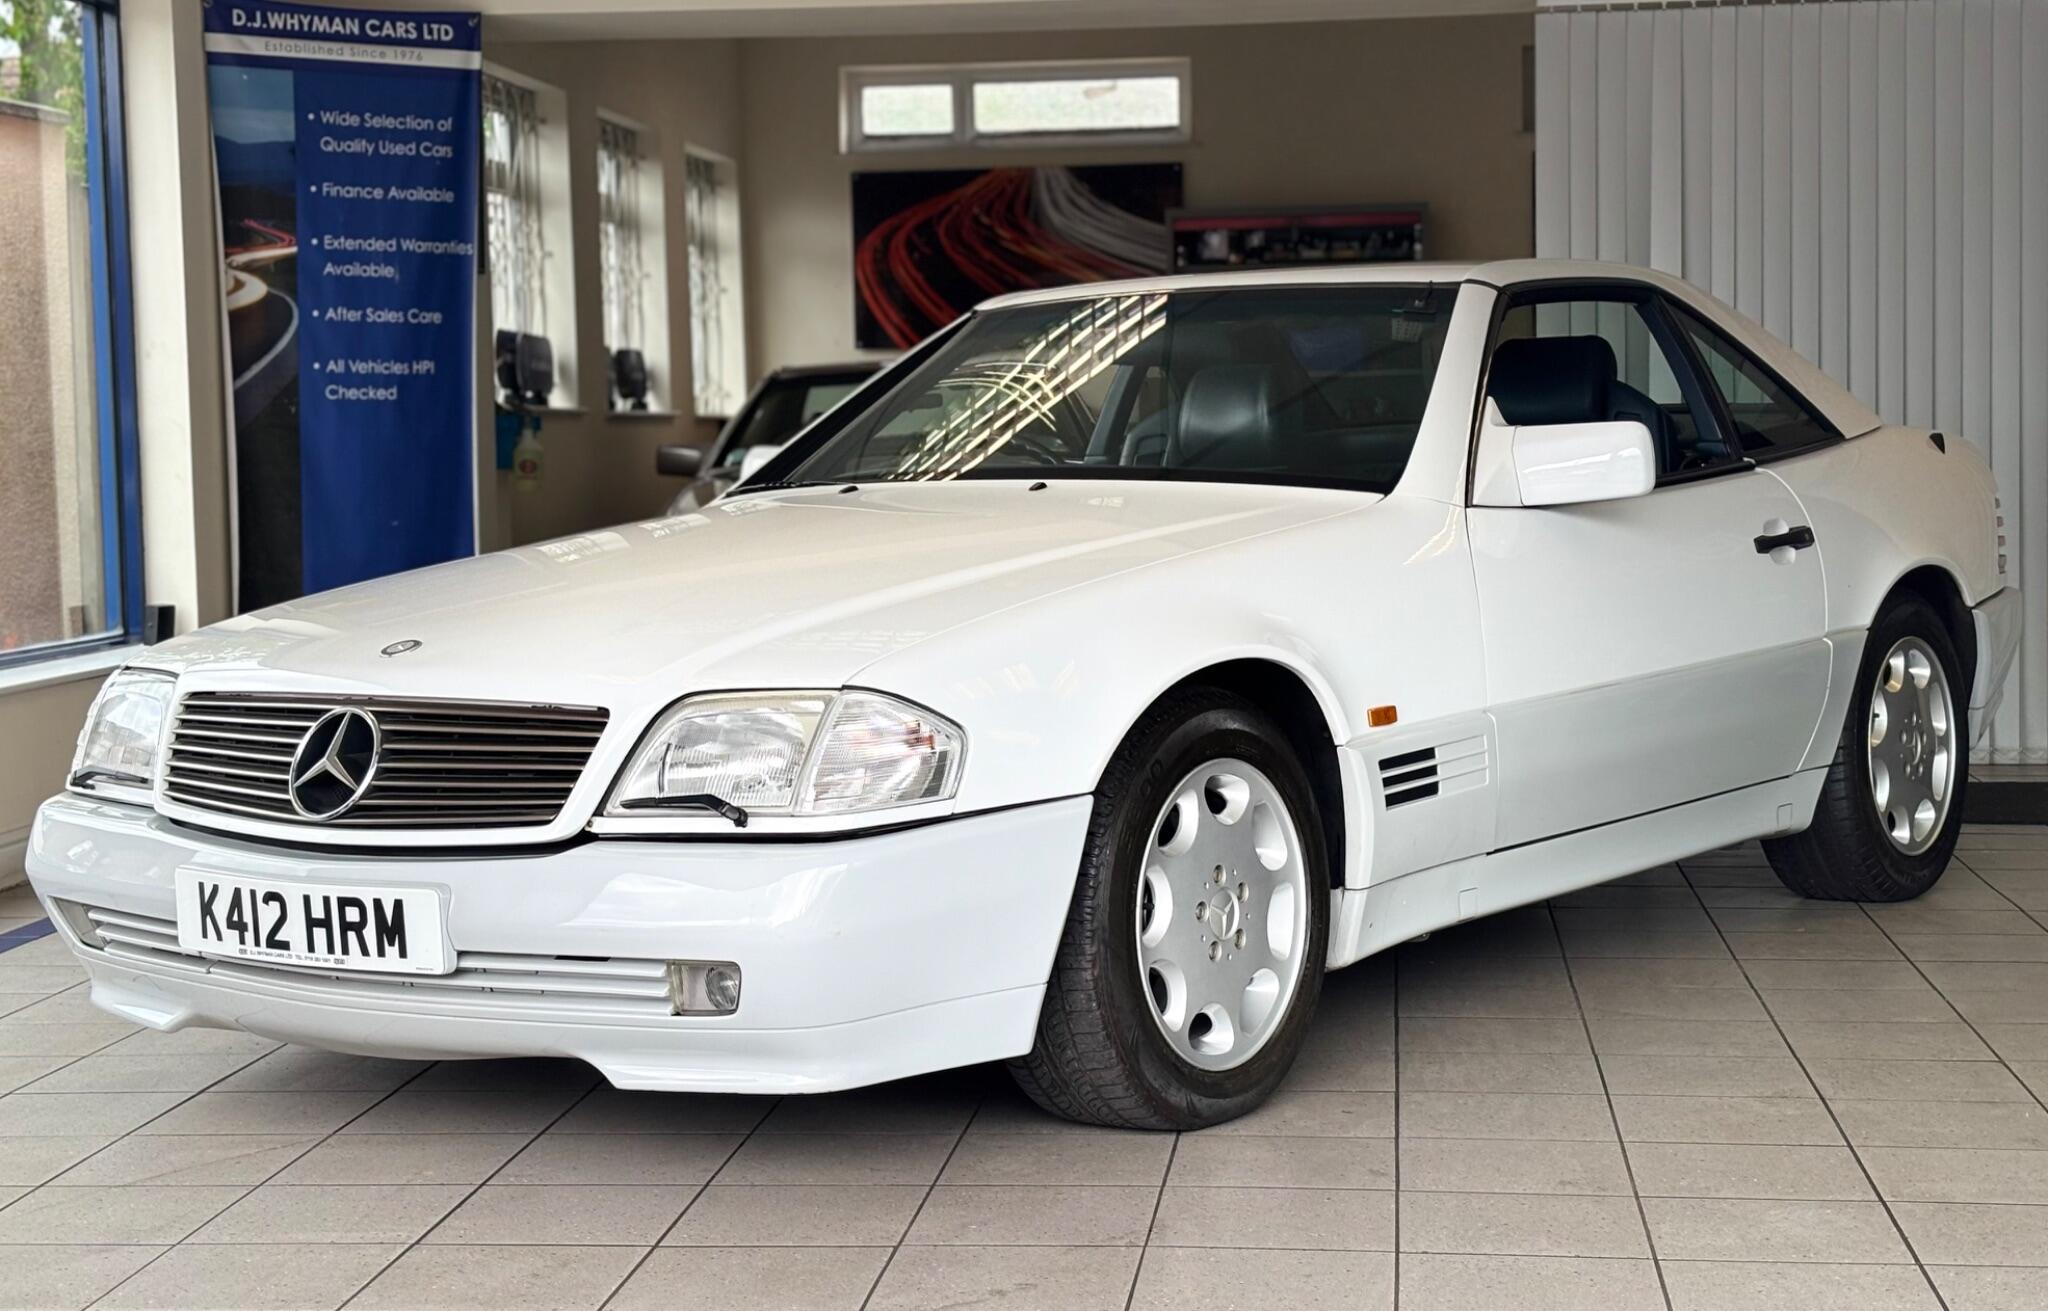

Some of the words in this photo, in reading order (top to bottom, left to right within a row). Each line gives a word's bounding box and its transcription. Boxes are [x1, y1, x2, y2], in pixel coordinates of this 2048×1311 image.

[231, 8, 360, 36] D.J.WHYMAN
[365, 19, 418, 40] CARS
[422, 23, 454, 42] LTD
[264, 40, 344, 57] Established
[349, 46, 387, 60] Since
[392, 50, 424, 62] 1976
[320, 110, 361, 127] Wide
[363, 112, 433, 131] Selection
[437, 116, 453, 132] of
[320, 136, 373, 157] Quality
[378, 140, 416, 156] Used
[419, 142, 454, 158] Cars
[322, 182, 384, 200] Finance
[387, 186, 454, 203] Available
[323, 234, 397, 252] Extended
[400, 237, 474, 255] Warranties
[324, 307, 362, 322] After
[366, 307, 404, 323] Sales
[407, 308, 443, 324] Care
[325, 359, 345, 374] All
[348, 359, 409, 375] Vehicles
[412, 360, 435, 374] HPI
[324, 384, 398, 401] Checked
[198, 881, 291, 951] K412
[302, 894, 408, 959] HRM
